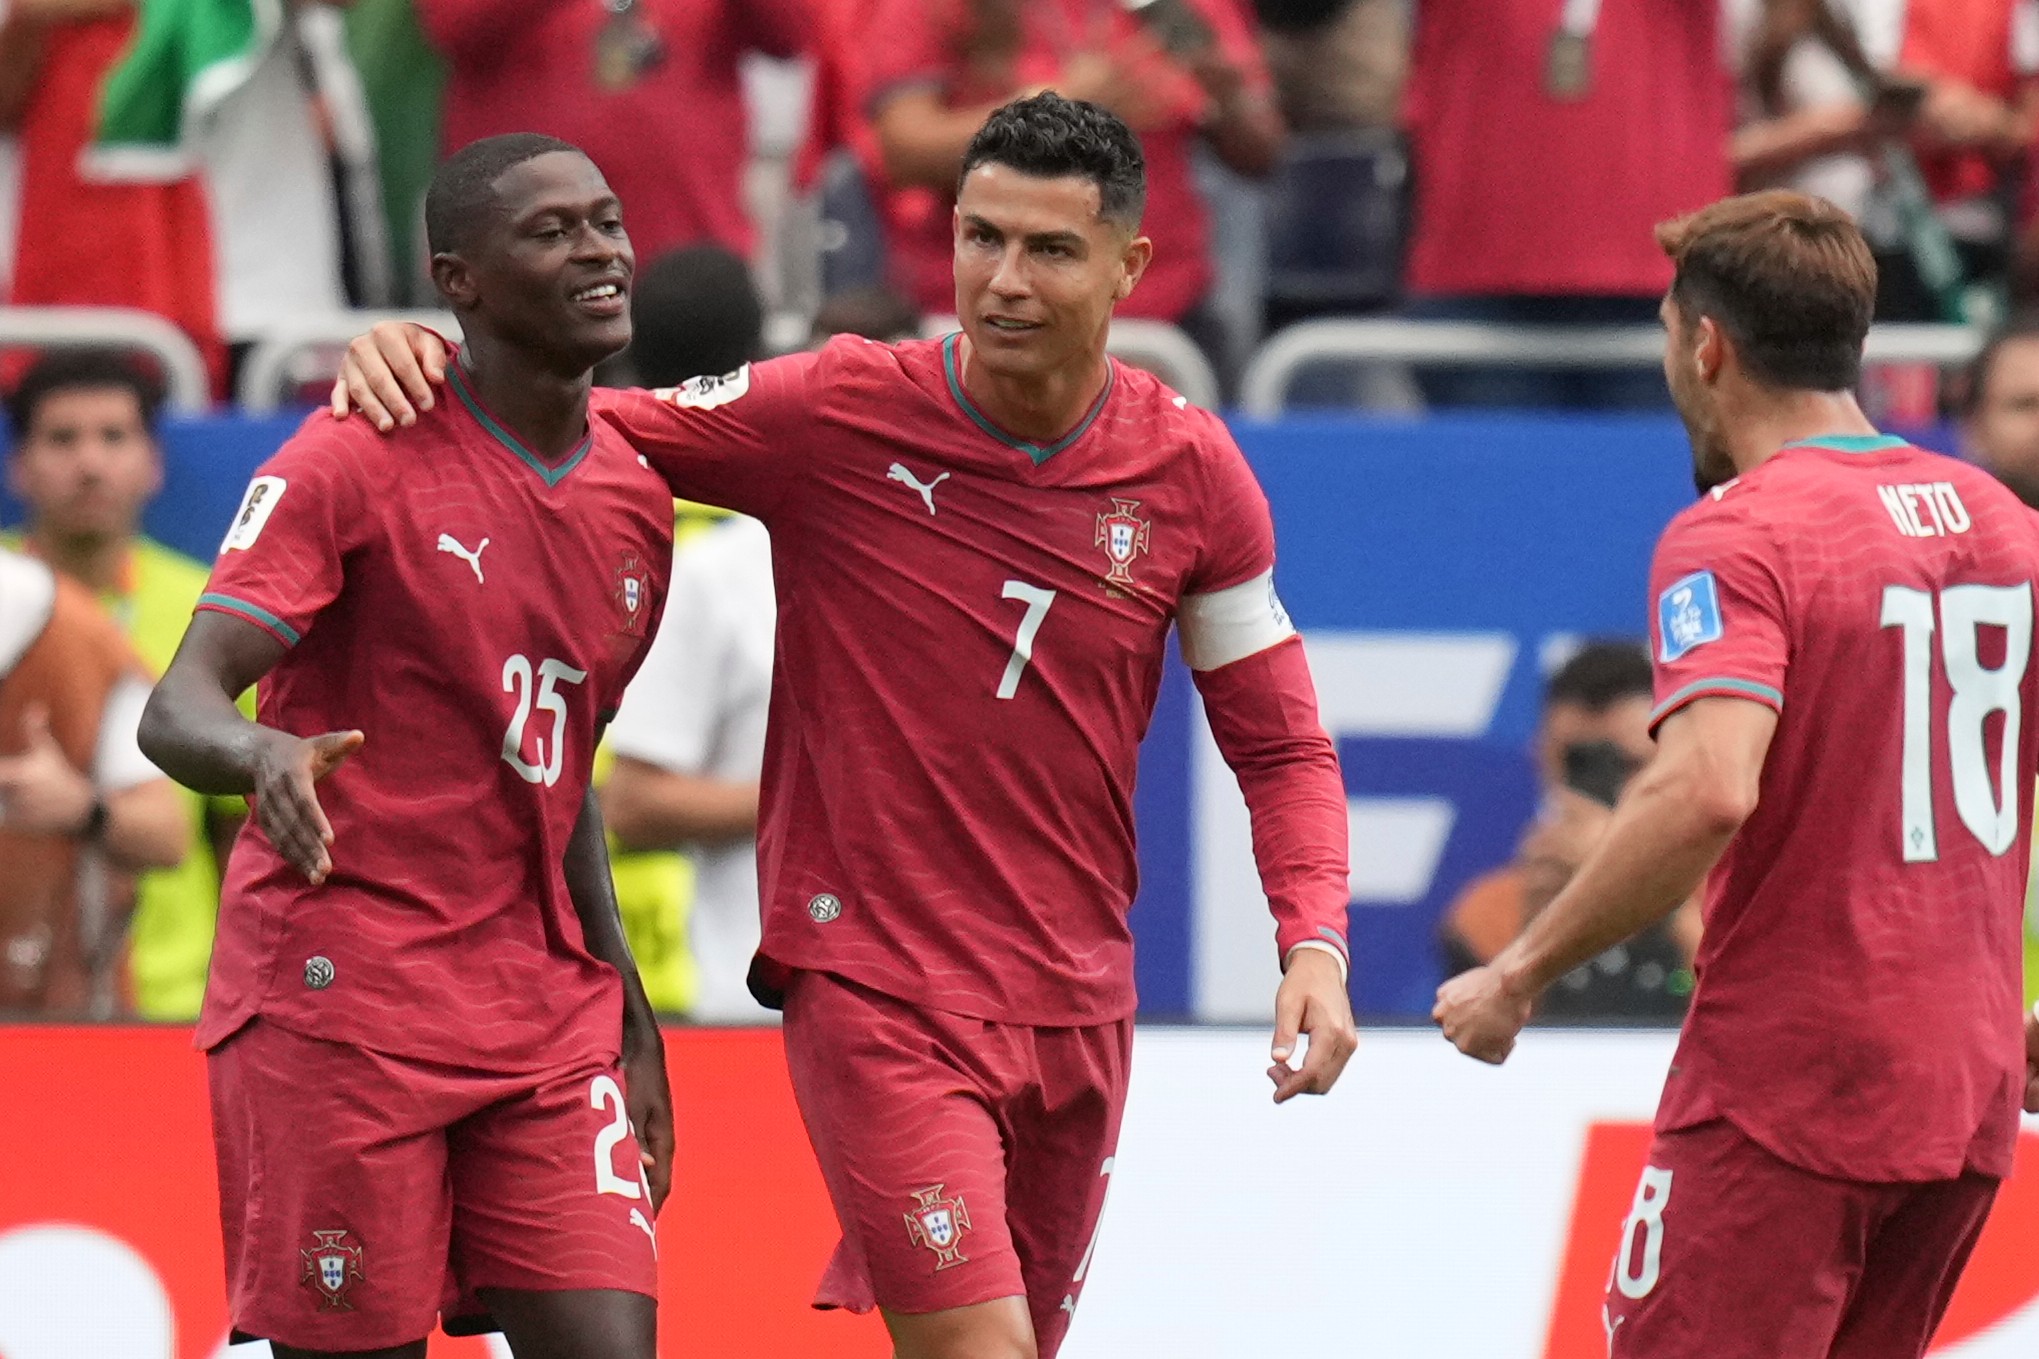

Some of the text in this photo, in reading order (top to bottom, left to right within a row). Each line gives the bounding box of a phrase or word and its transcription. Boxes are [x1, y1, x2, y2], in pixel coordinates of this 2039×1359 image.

[1877, 481, 1972, 537] NETO
[996, 579, 1057, 699] 7
[501, 653, 588, 788] 25
[1880, 580, 2033, 862] 18
[590, 1075, 653, 1208] 2
[1606, 1165, 1674, 1300] 8
